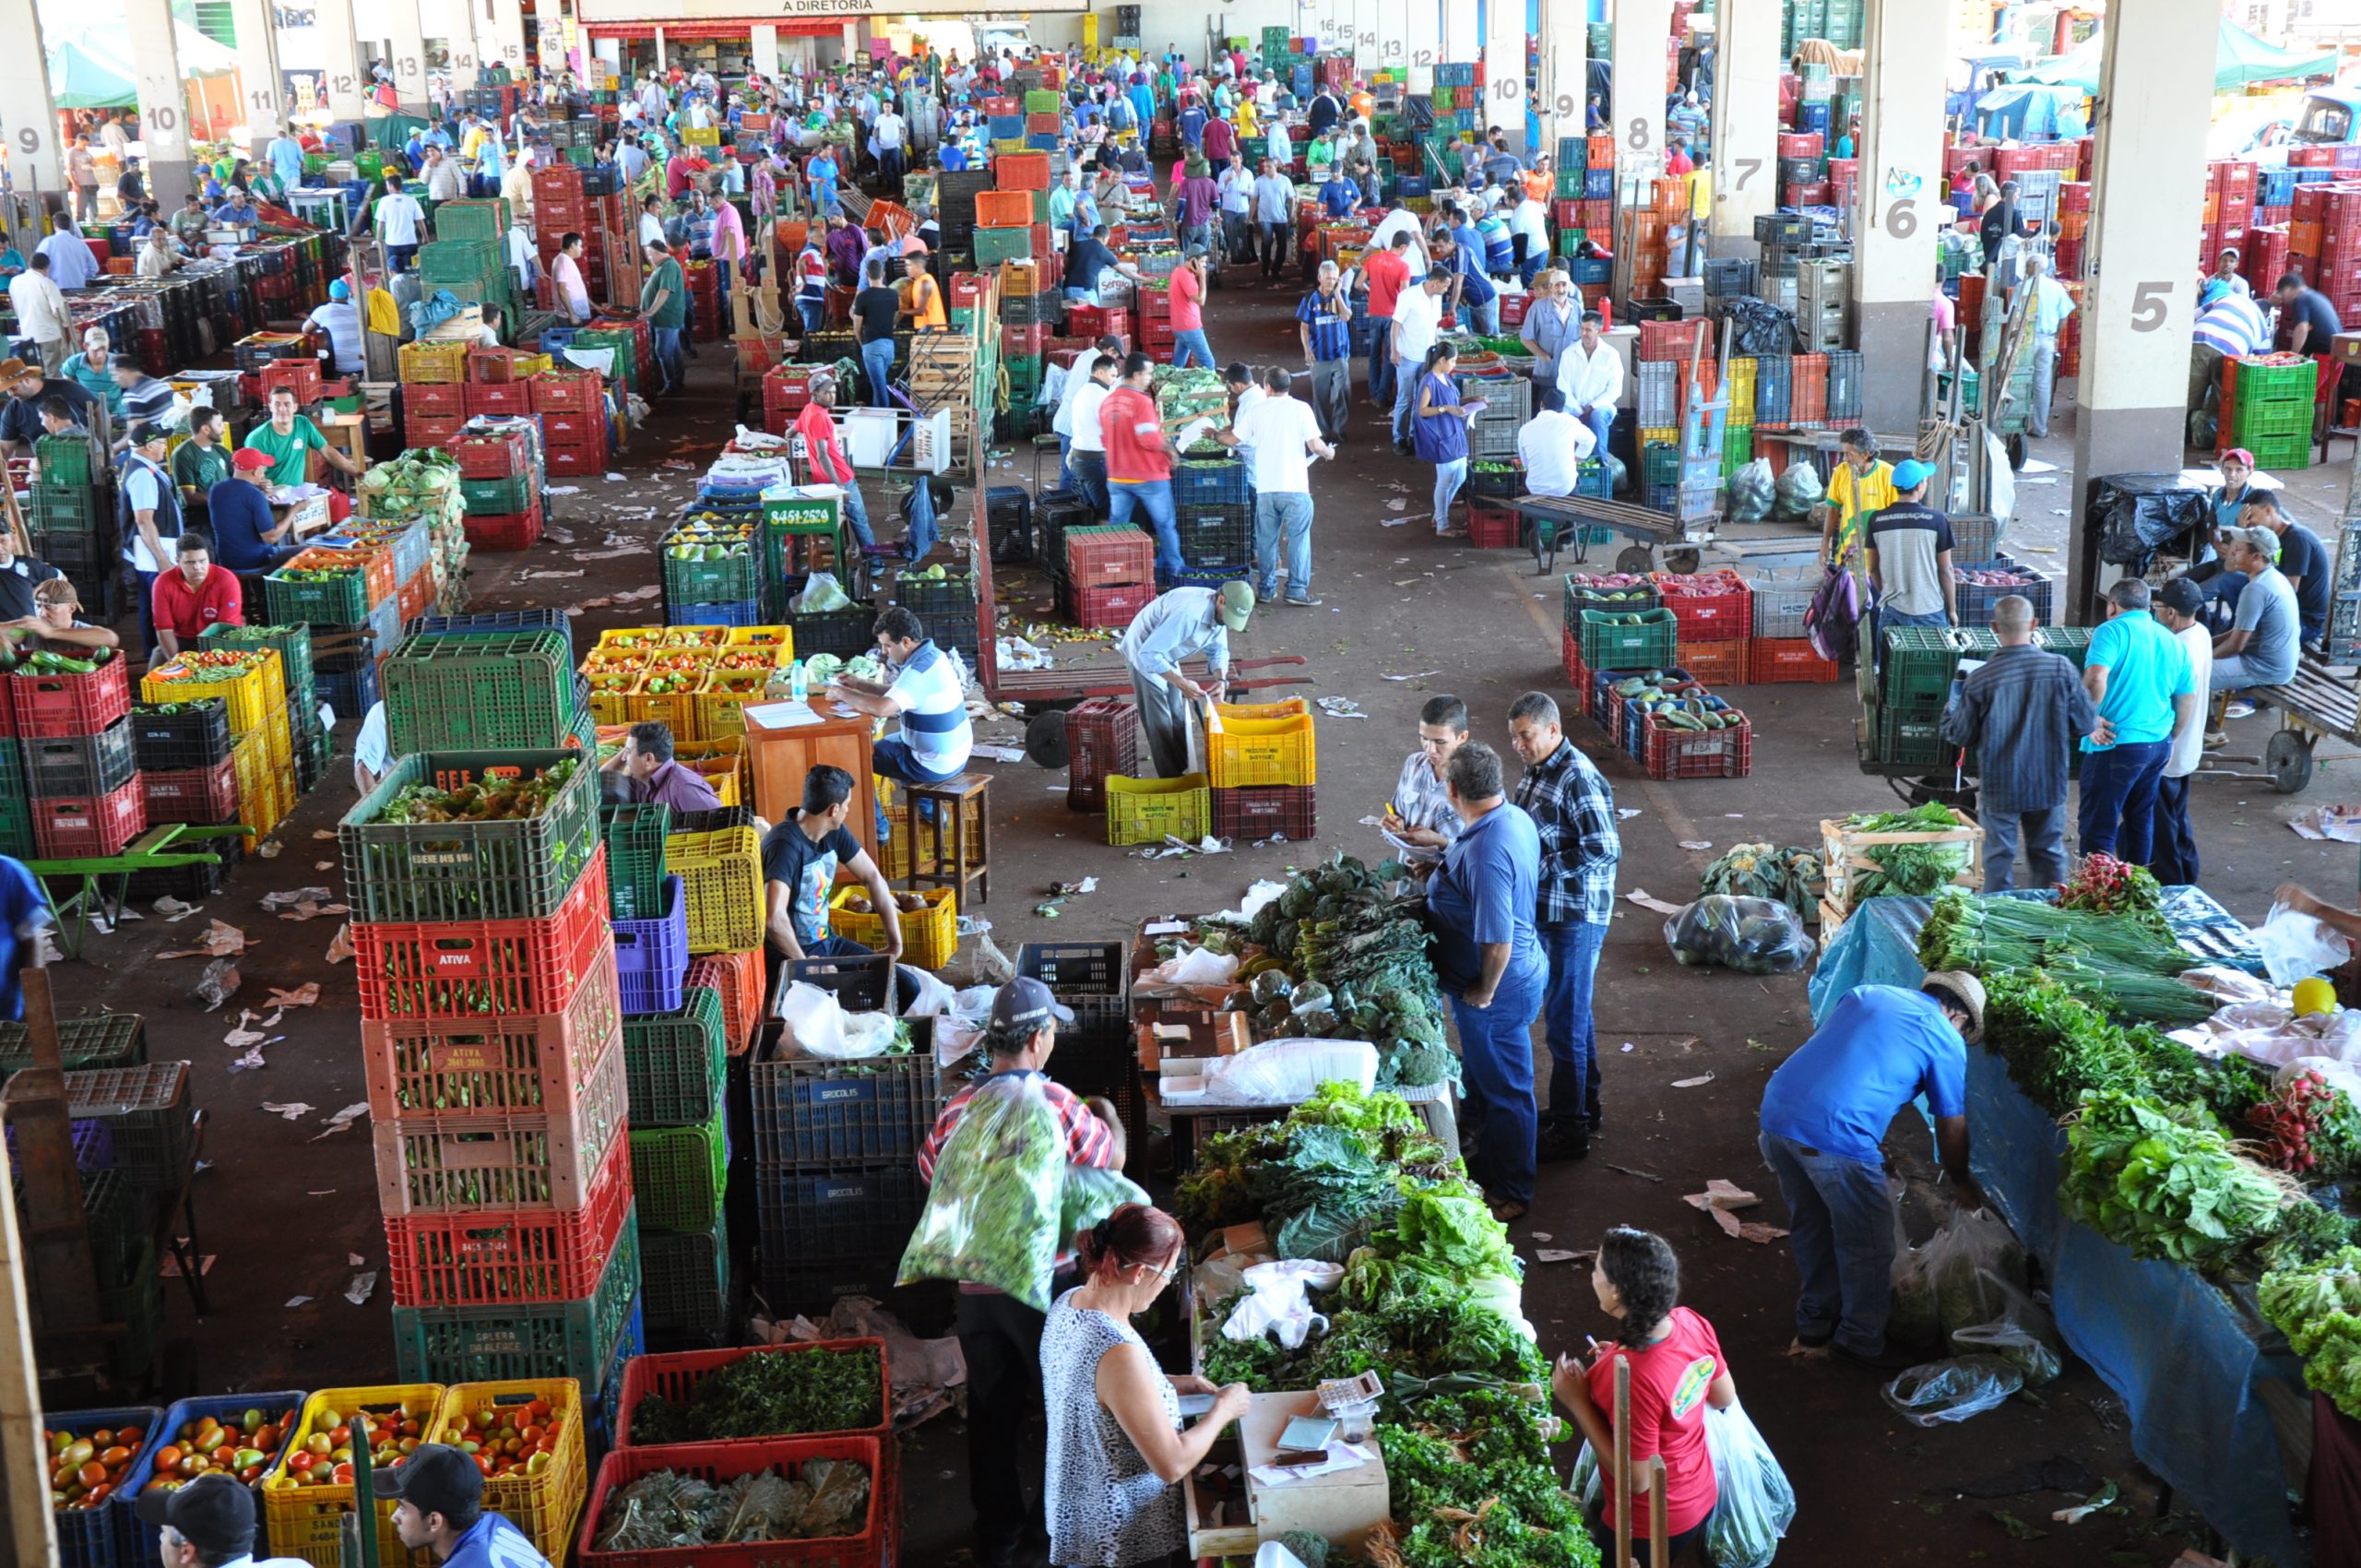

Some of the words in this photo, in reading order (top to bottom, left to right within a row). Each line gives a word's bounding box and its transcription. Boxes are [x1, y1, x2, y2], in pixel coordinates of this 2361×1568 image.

[783, 0, 792, 11] A
[798, 0, 873, 12] DIRETORIA
[1321, 19, 1335, 31] 16
[1337, 24, 1354, 40] 15
[544, 38, 559, 52] 16
[1358, 31, 1377, 47] 14
[503, 45, 518, 59] 15
[1382, 40, 1402, 57] 13
[455, 54, 473, 70] 14
[1412, 50, 1433, 67] 12
[397, 57, 419, 77] 13
[333, 76, 353, 93] 12
[1492, 77, 1519, 101] 10
[251, 90, 271, 110] 11
[1556, 94, 1574, 119] 9
[148, 107, 176, 131] 10
[18, 127, 40, 155] 9
[1628, 117, 1649, 150] 8
[1735, 158, 1762, 191] 7
[1886, 199, 1917, 240] 6
[2086, 287, 2094, 312] 5
[2130, 281, 2174, 333] 5
[439, 955, 471, 965] ATIVA
[453, 1049, 481, 1058] ATIVA
[822, 1088, 859, 1099] BROCOLIS
[827, 1187, 864, 1198] BROCOLIS
[476, 1331, 516, 1342] GALERA
[469, 1343, 484, 1354] DA
[485, 1341, 522, 1353] ALFACE
[313, 1519, 342, 1531] SAND
[310, 1533, 341, 1543] 8484-
